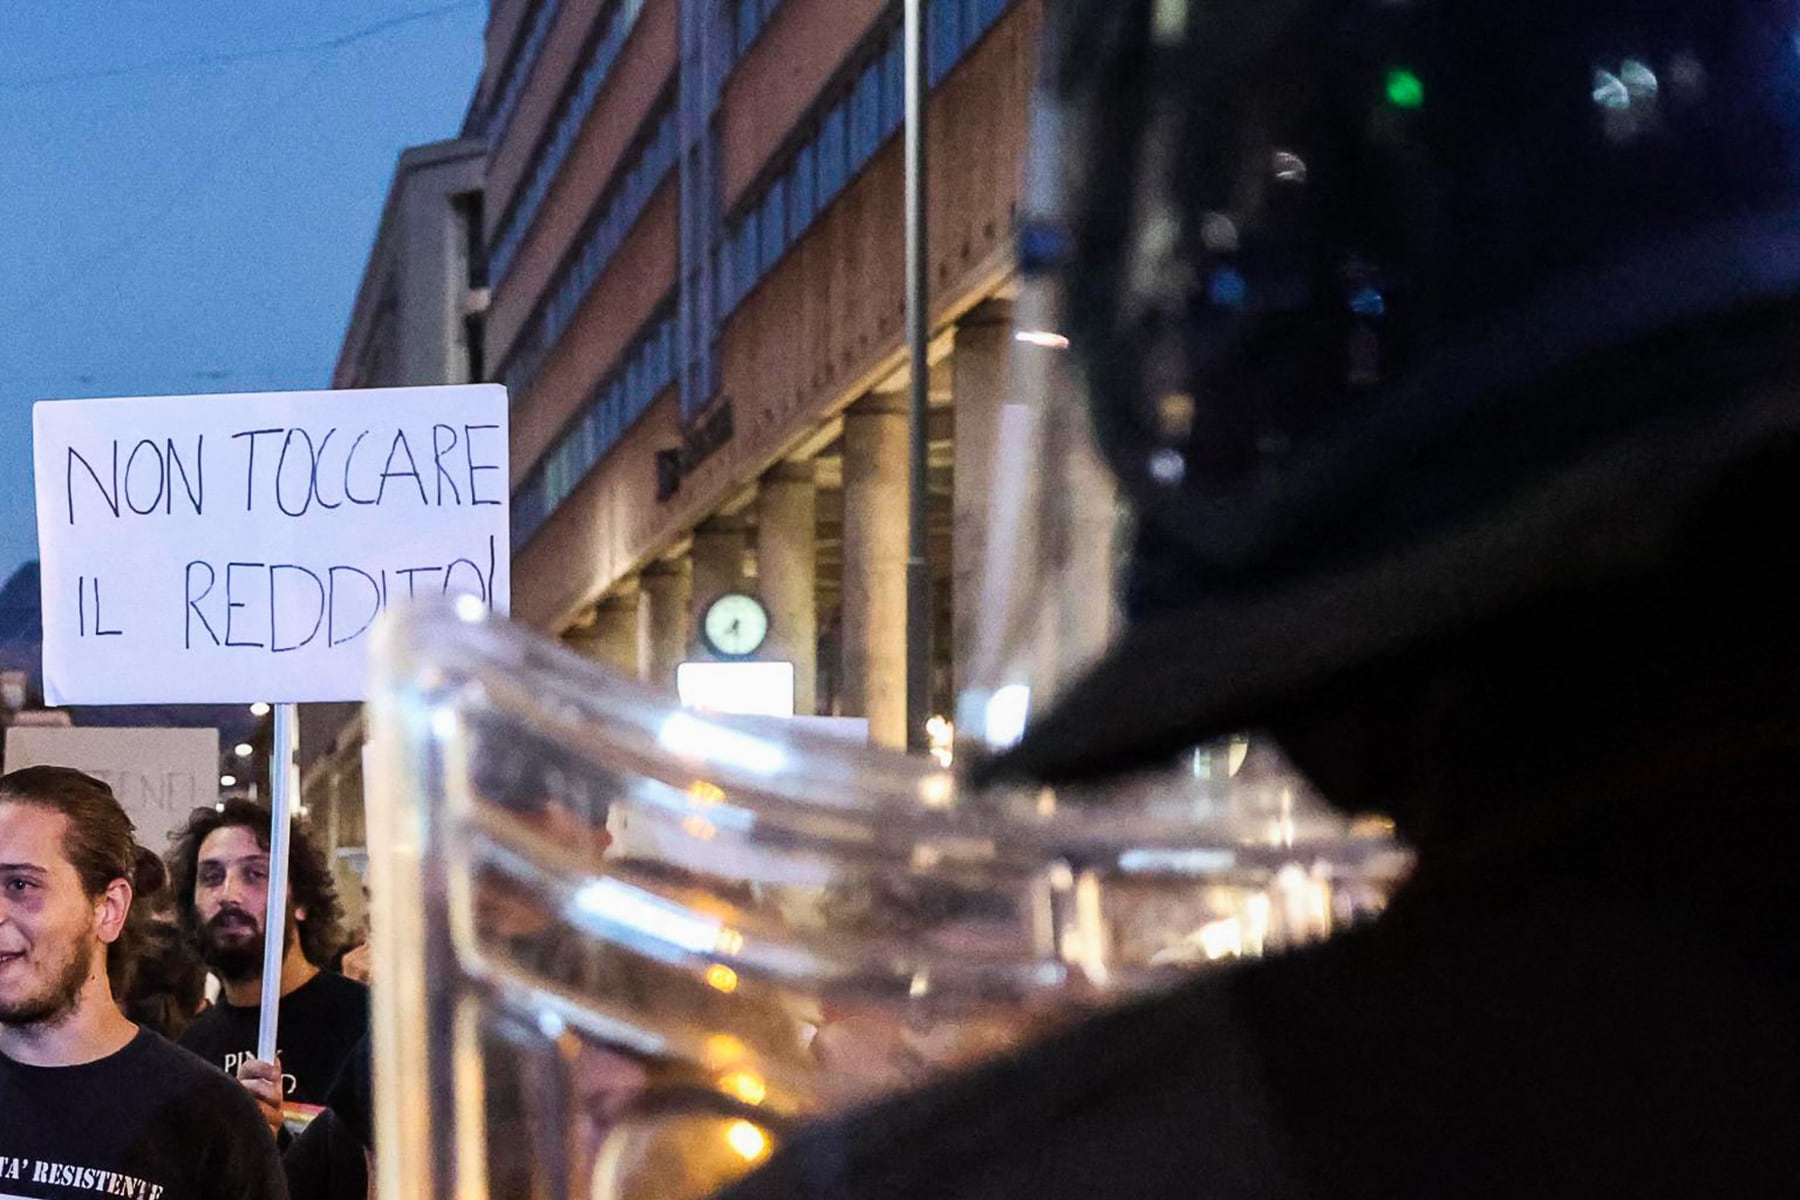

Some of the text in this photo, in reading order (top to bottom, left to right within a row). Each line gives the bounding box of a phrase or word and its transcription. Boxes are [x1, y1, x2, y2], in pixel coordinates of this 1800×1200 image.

[67, 424, 503, 525] NON TOCCARE
[78, 575, 123, 637] IL
